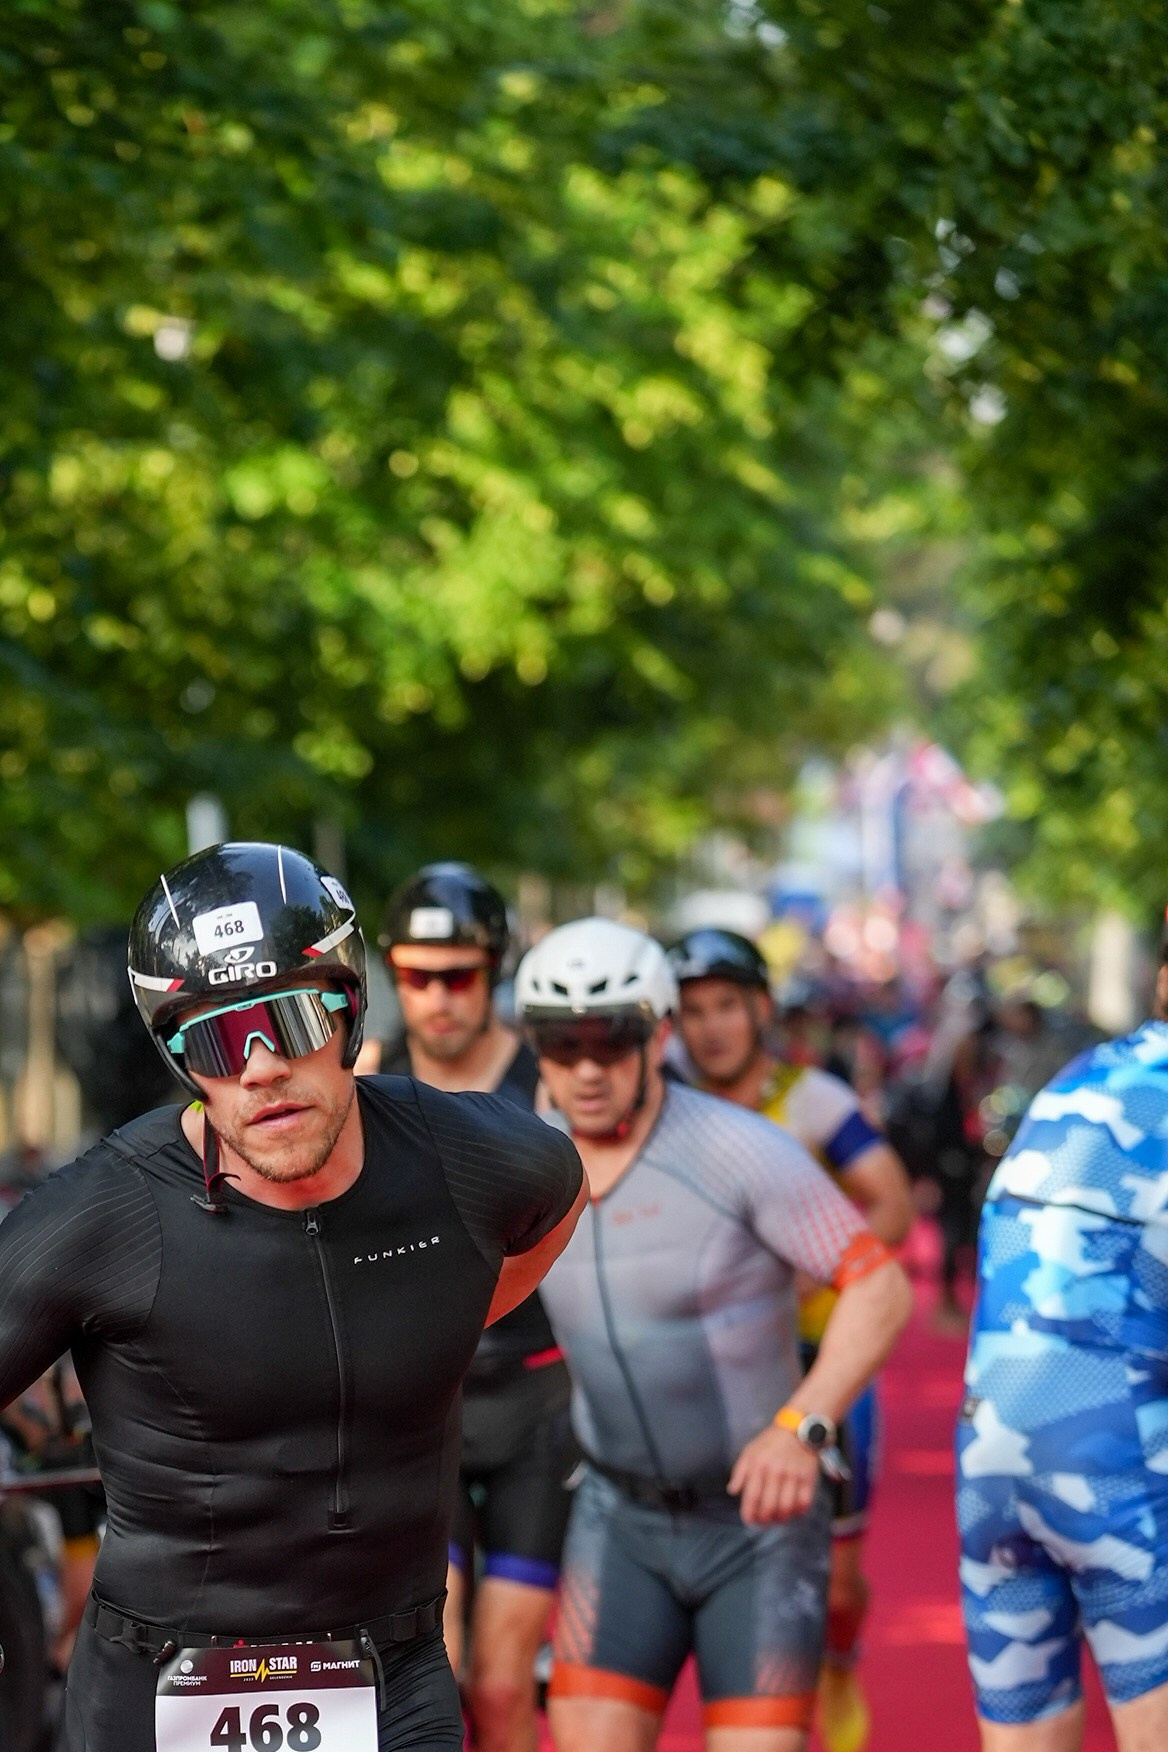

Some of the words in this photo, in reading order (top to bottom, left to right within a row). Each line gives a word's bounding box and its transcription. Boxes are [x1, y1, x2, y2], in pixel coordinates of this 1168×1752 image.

[214, 919, 245, 939] 468
[208, 961, 278, 986] GIRO
[353, 1236, 440, 1265] FUNKIER
[230, 1658, 257, 1673] IRON
[268, 1656, 298, 1671] STAR
[322, 1660, 361, 1670] МАГНИТ
